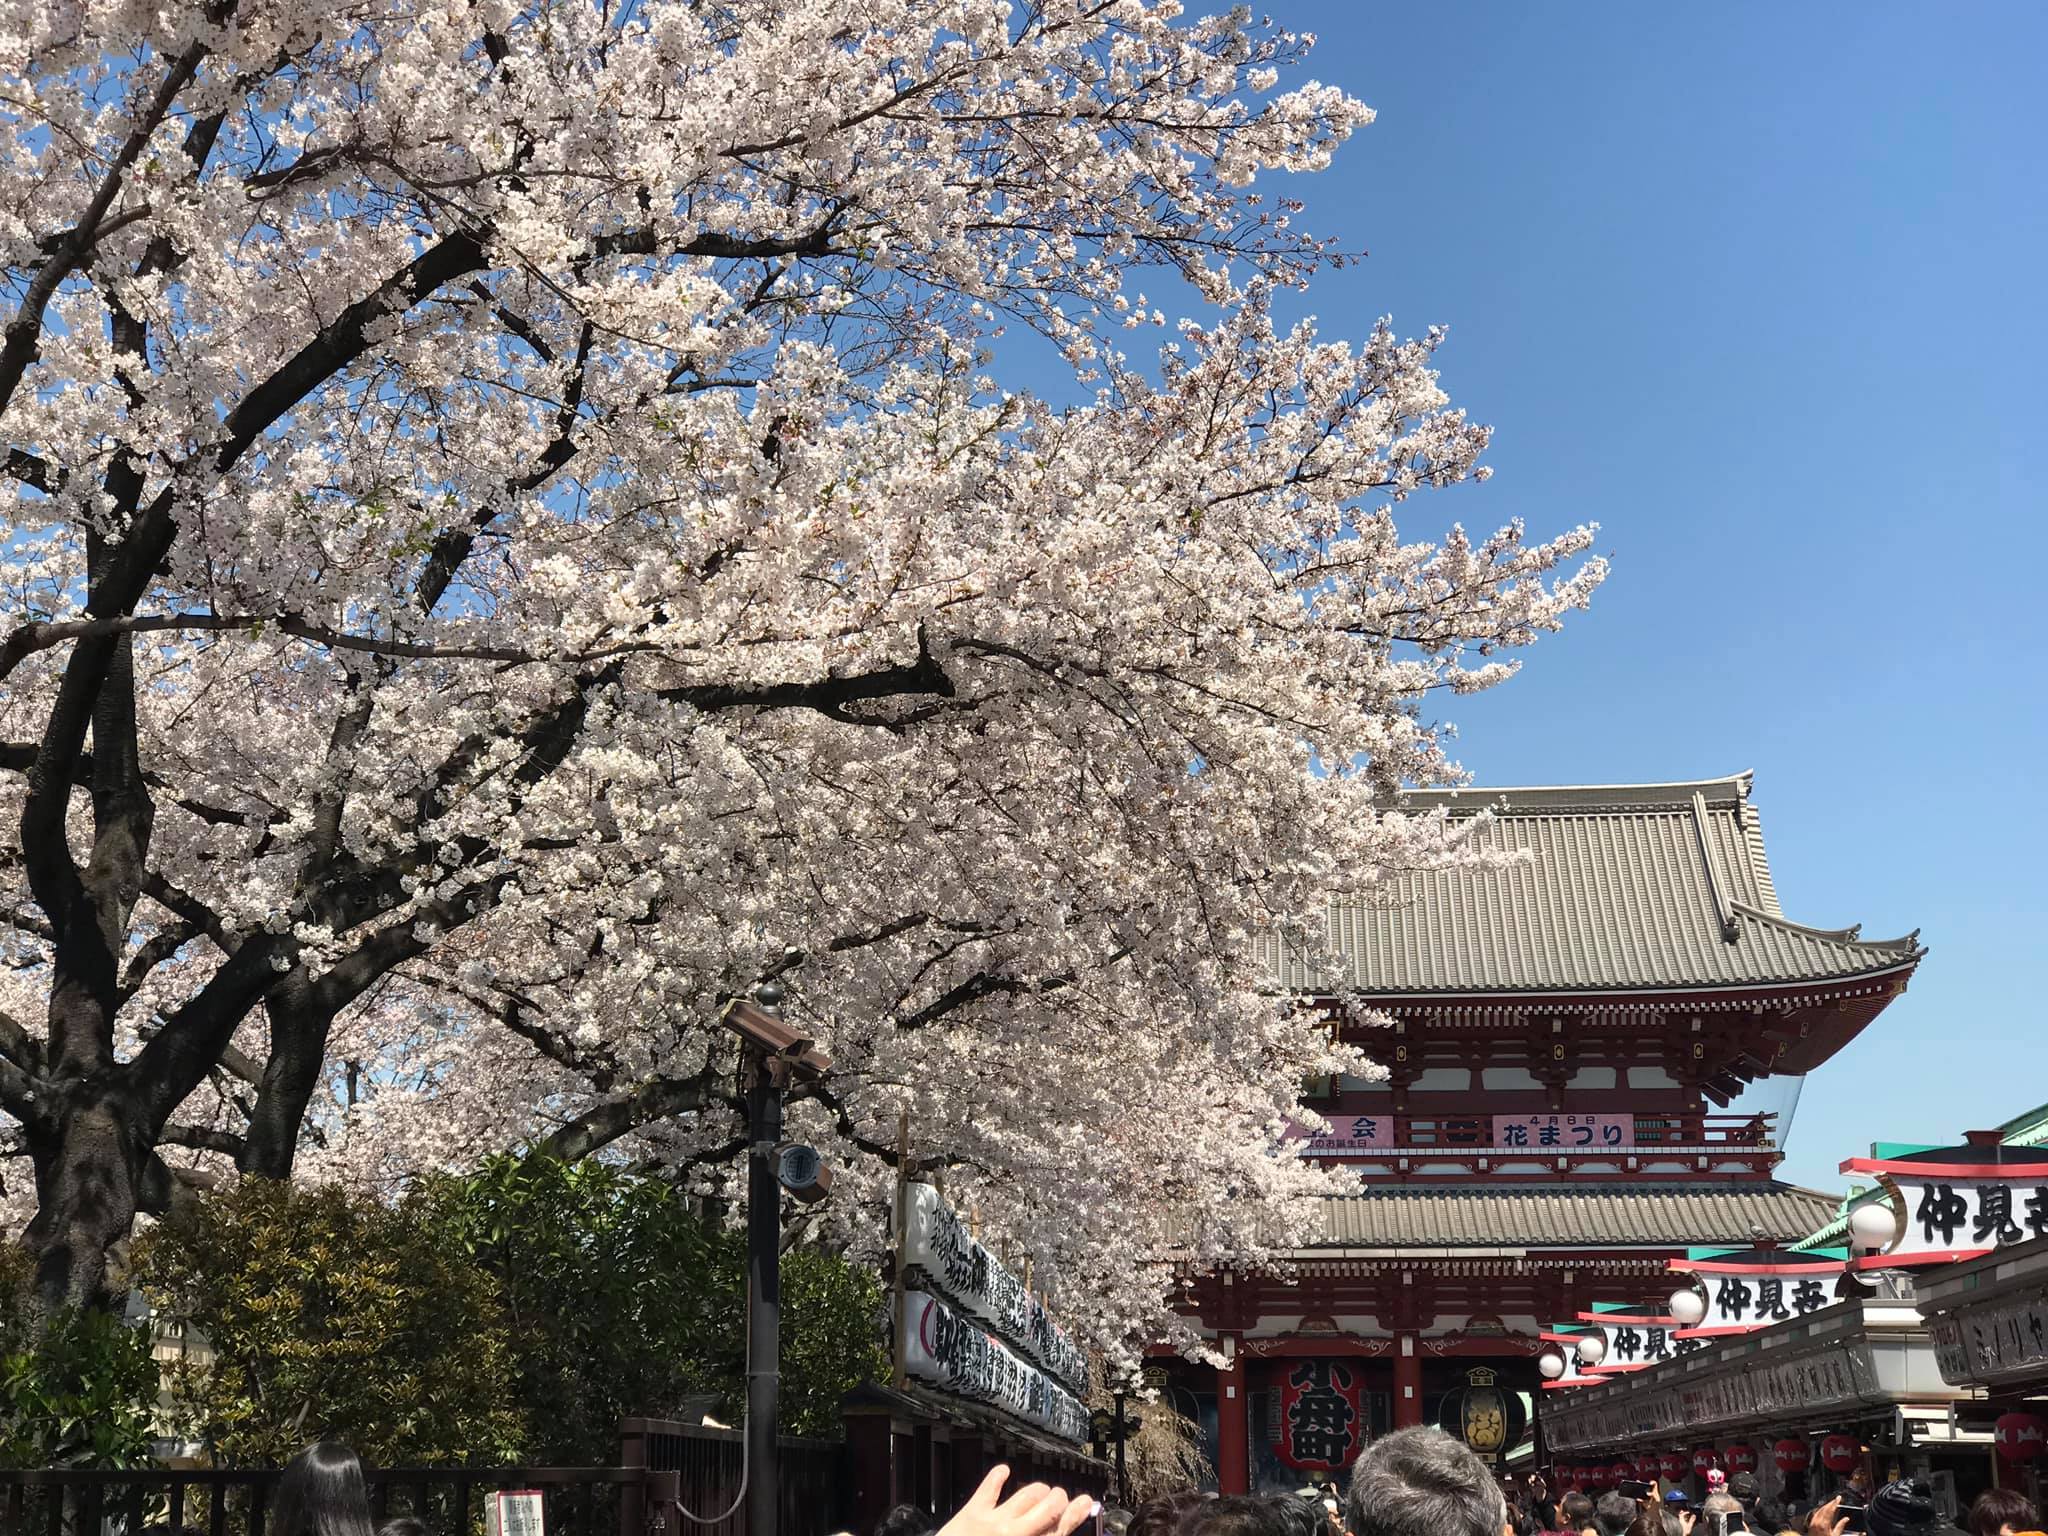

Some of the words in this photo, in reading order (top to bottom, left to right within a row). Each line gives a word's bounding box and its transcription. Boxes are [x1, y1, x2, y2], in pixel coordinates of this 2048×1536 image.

[1504, 1124, 1622, 1146] 花まつり
[1530, 1116, 1595, 1125] 4月8日
[1716, 1276, 1828, 1321] 仲見世
[1288, 1361, 1355, 1467] 小舟町
